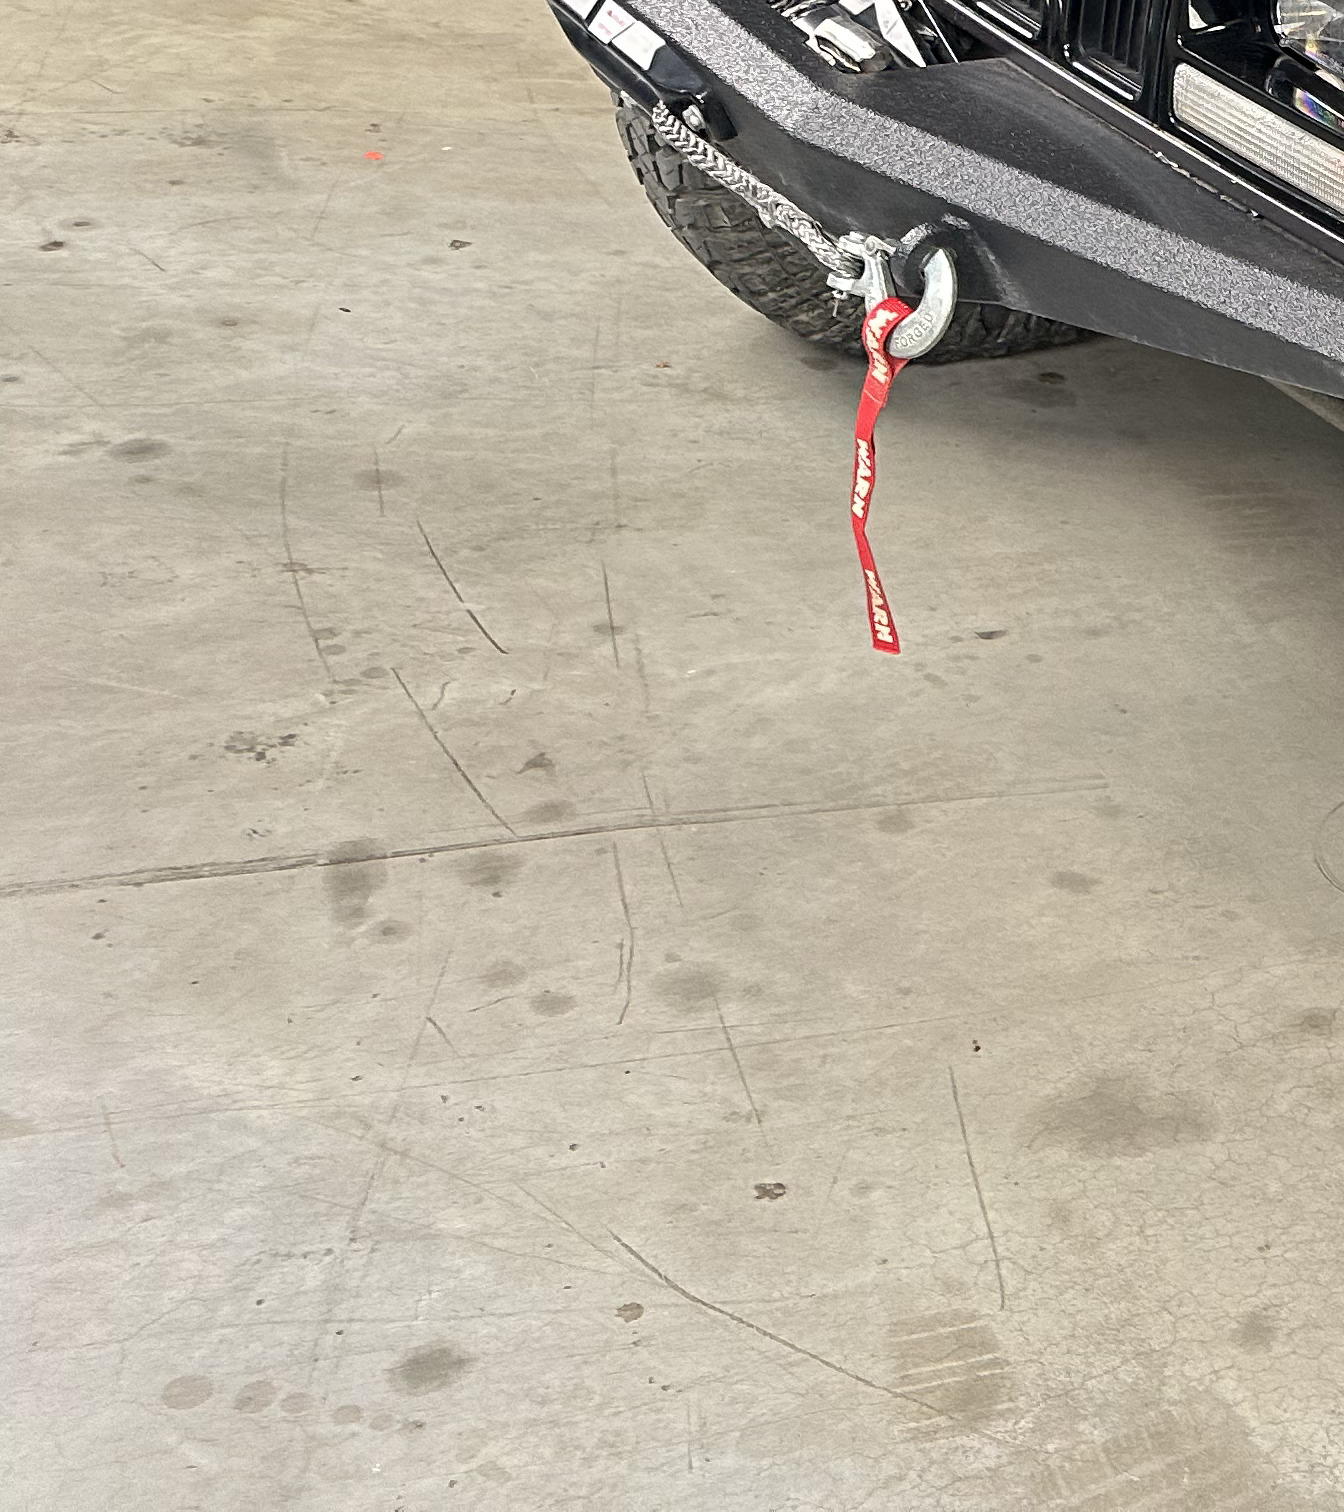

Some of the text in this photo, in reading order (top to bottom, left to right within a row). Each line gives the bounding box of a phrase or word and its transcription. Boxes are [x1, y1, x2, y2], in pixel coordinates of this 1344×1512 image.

[894, 312, 934, 349] FORGED
[851, 438, 872, 519] WARN
[864, 569, 893, 644] WARN
